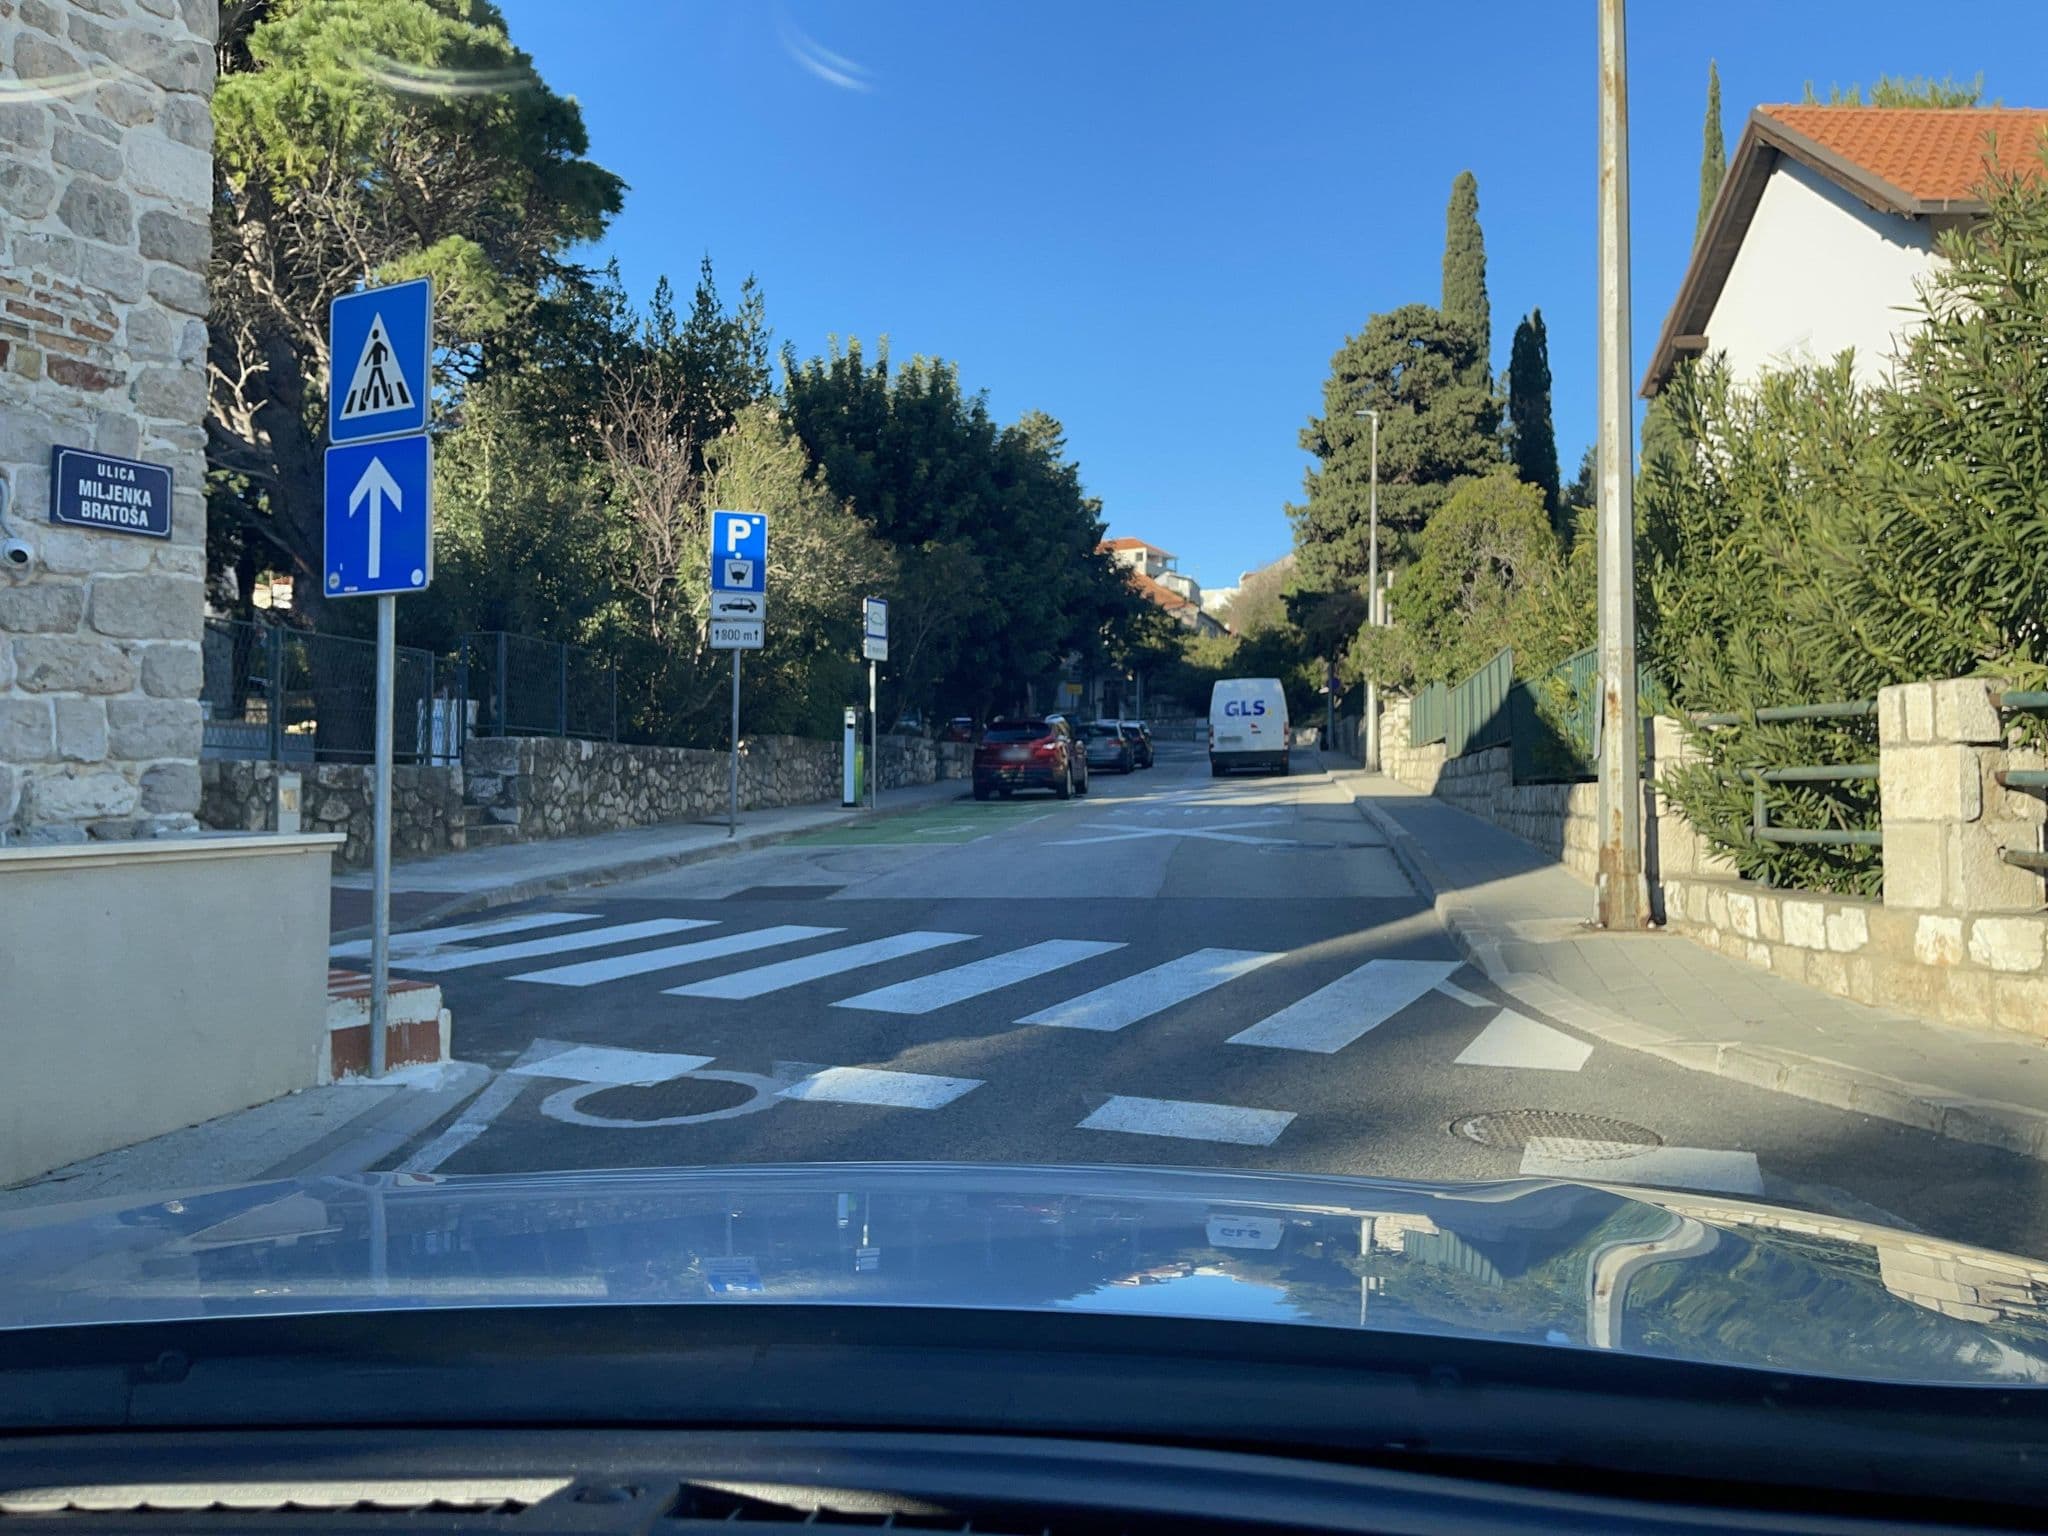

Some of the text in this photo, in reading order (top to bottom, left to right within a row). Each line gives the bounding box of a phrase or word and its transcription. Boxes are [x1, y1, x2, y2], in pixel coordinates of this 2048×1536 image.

[97, 463, 136, 482] ULICA
[78, 479, 153, 508] MILJENKA
[81, 501, 149, 527] BRATOŠA
[727, 518, 752, 552] P
[743, 632, 752, 640] m
[1224, 700, 1266, 717] GLS
